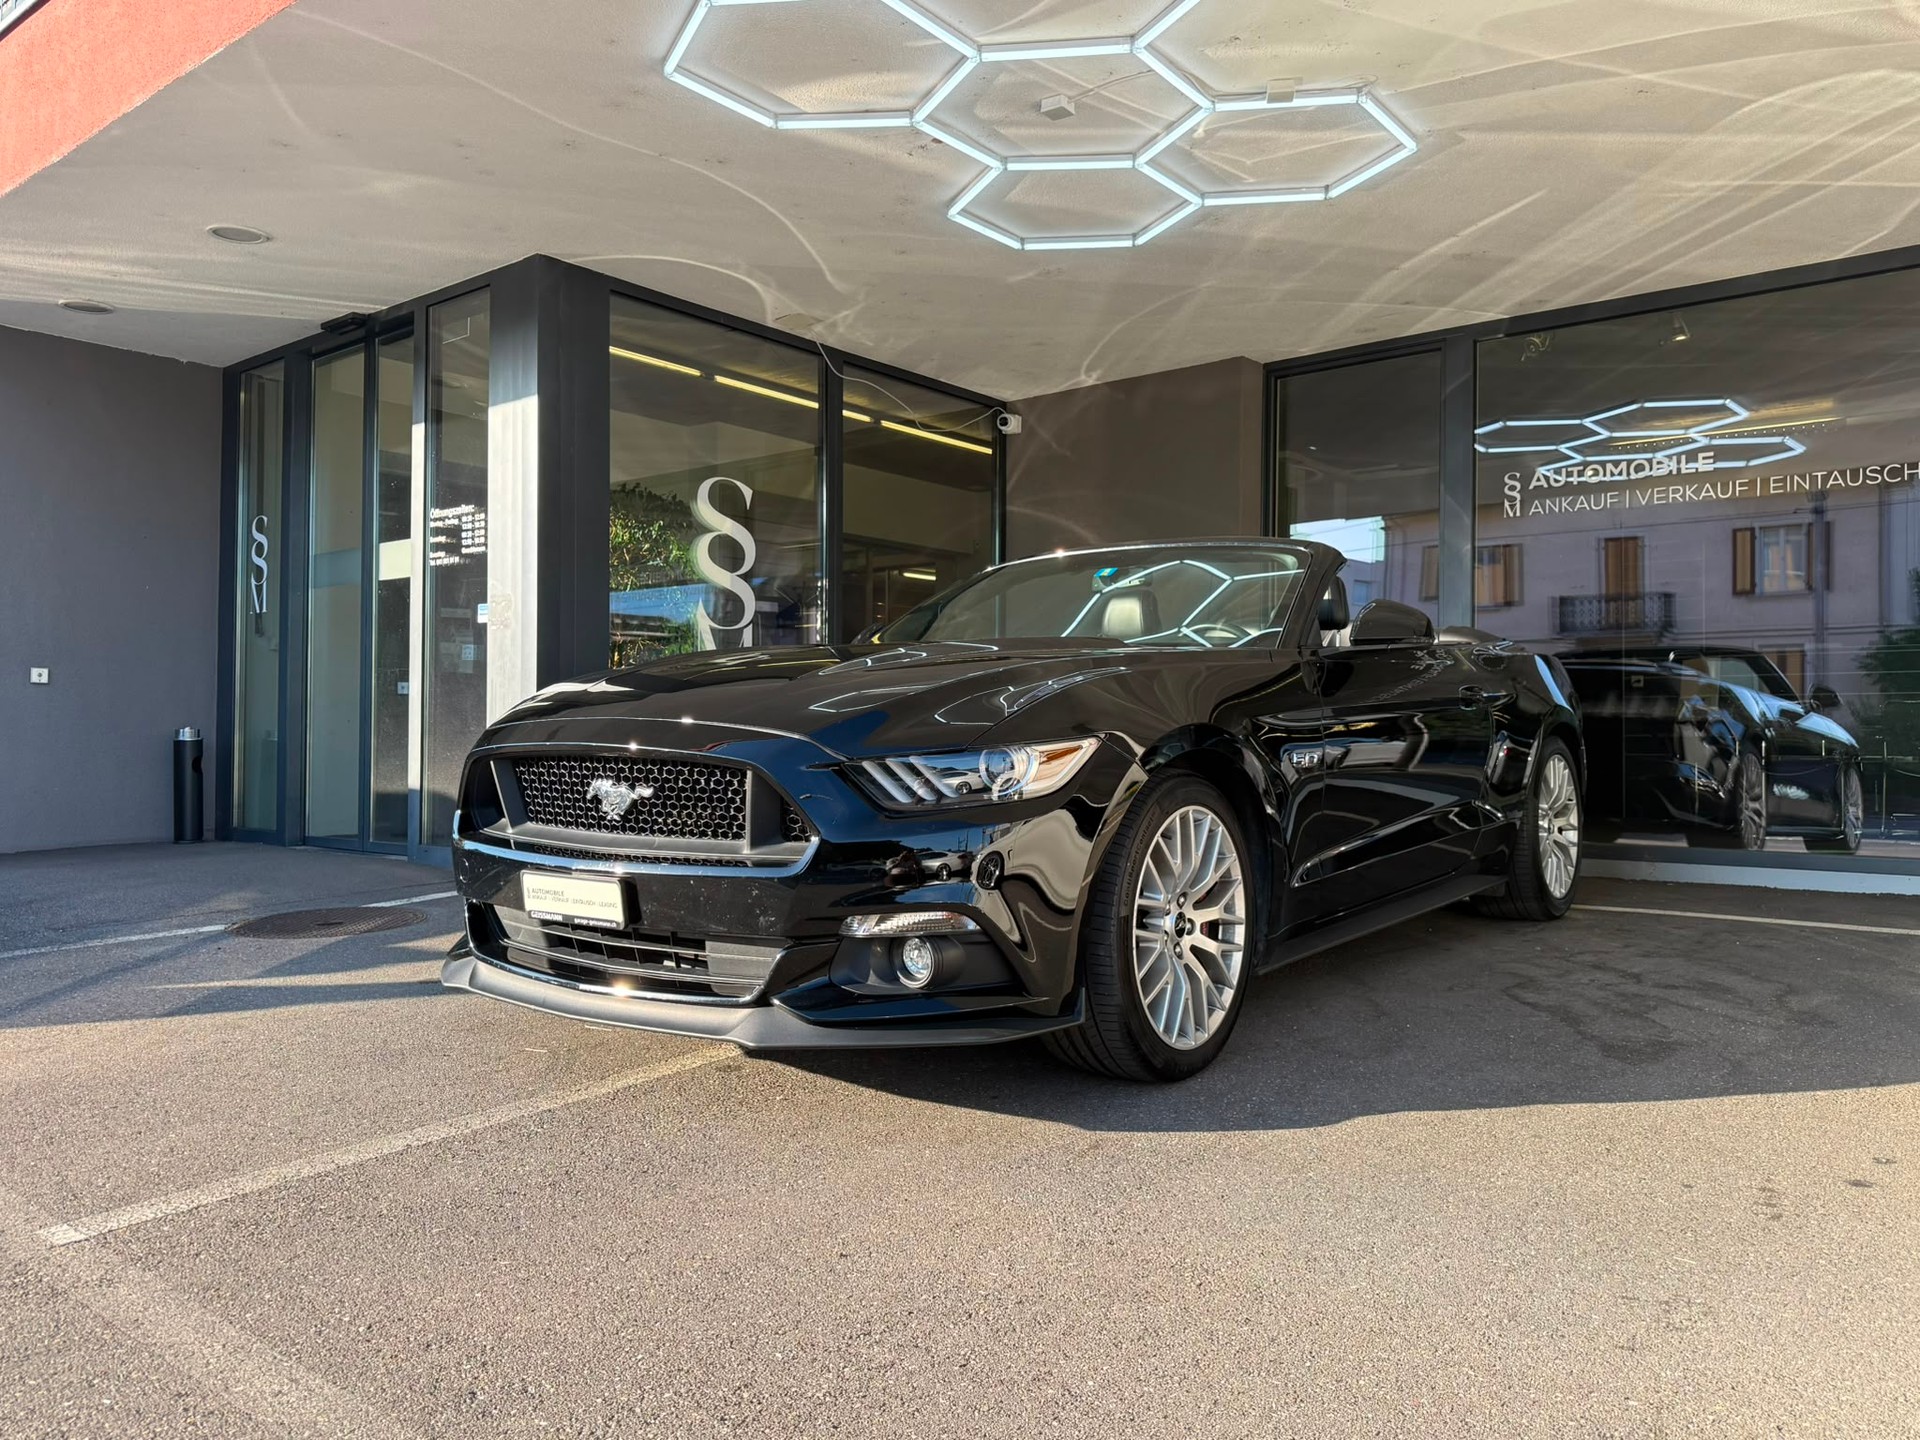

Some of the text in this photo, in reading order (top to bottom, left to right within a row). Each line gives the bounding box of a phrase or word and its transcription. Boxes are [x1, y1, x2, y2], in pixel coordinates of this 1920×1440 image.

[1528, 451, 1715, 490] AUTOMOBILE
[1528, 491, 1619, 517] ANKAUF
[1635, 479, 1749, 506] VERKAUF
[1769, 461, 1920, 494] EINTAUSCH
